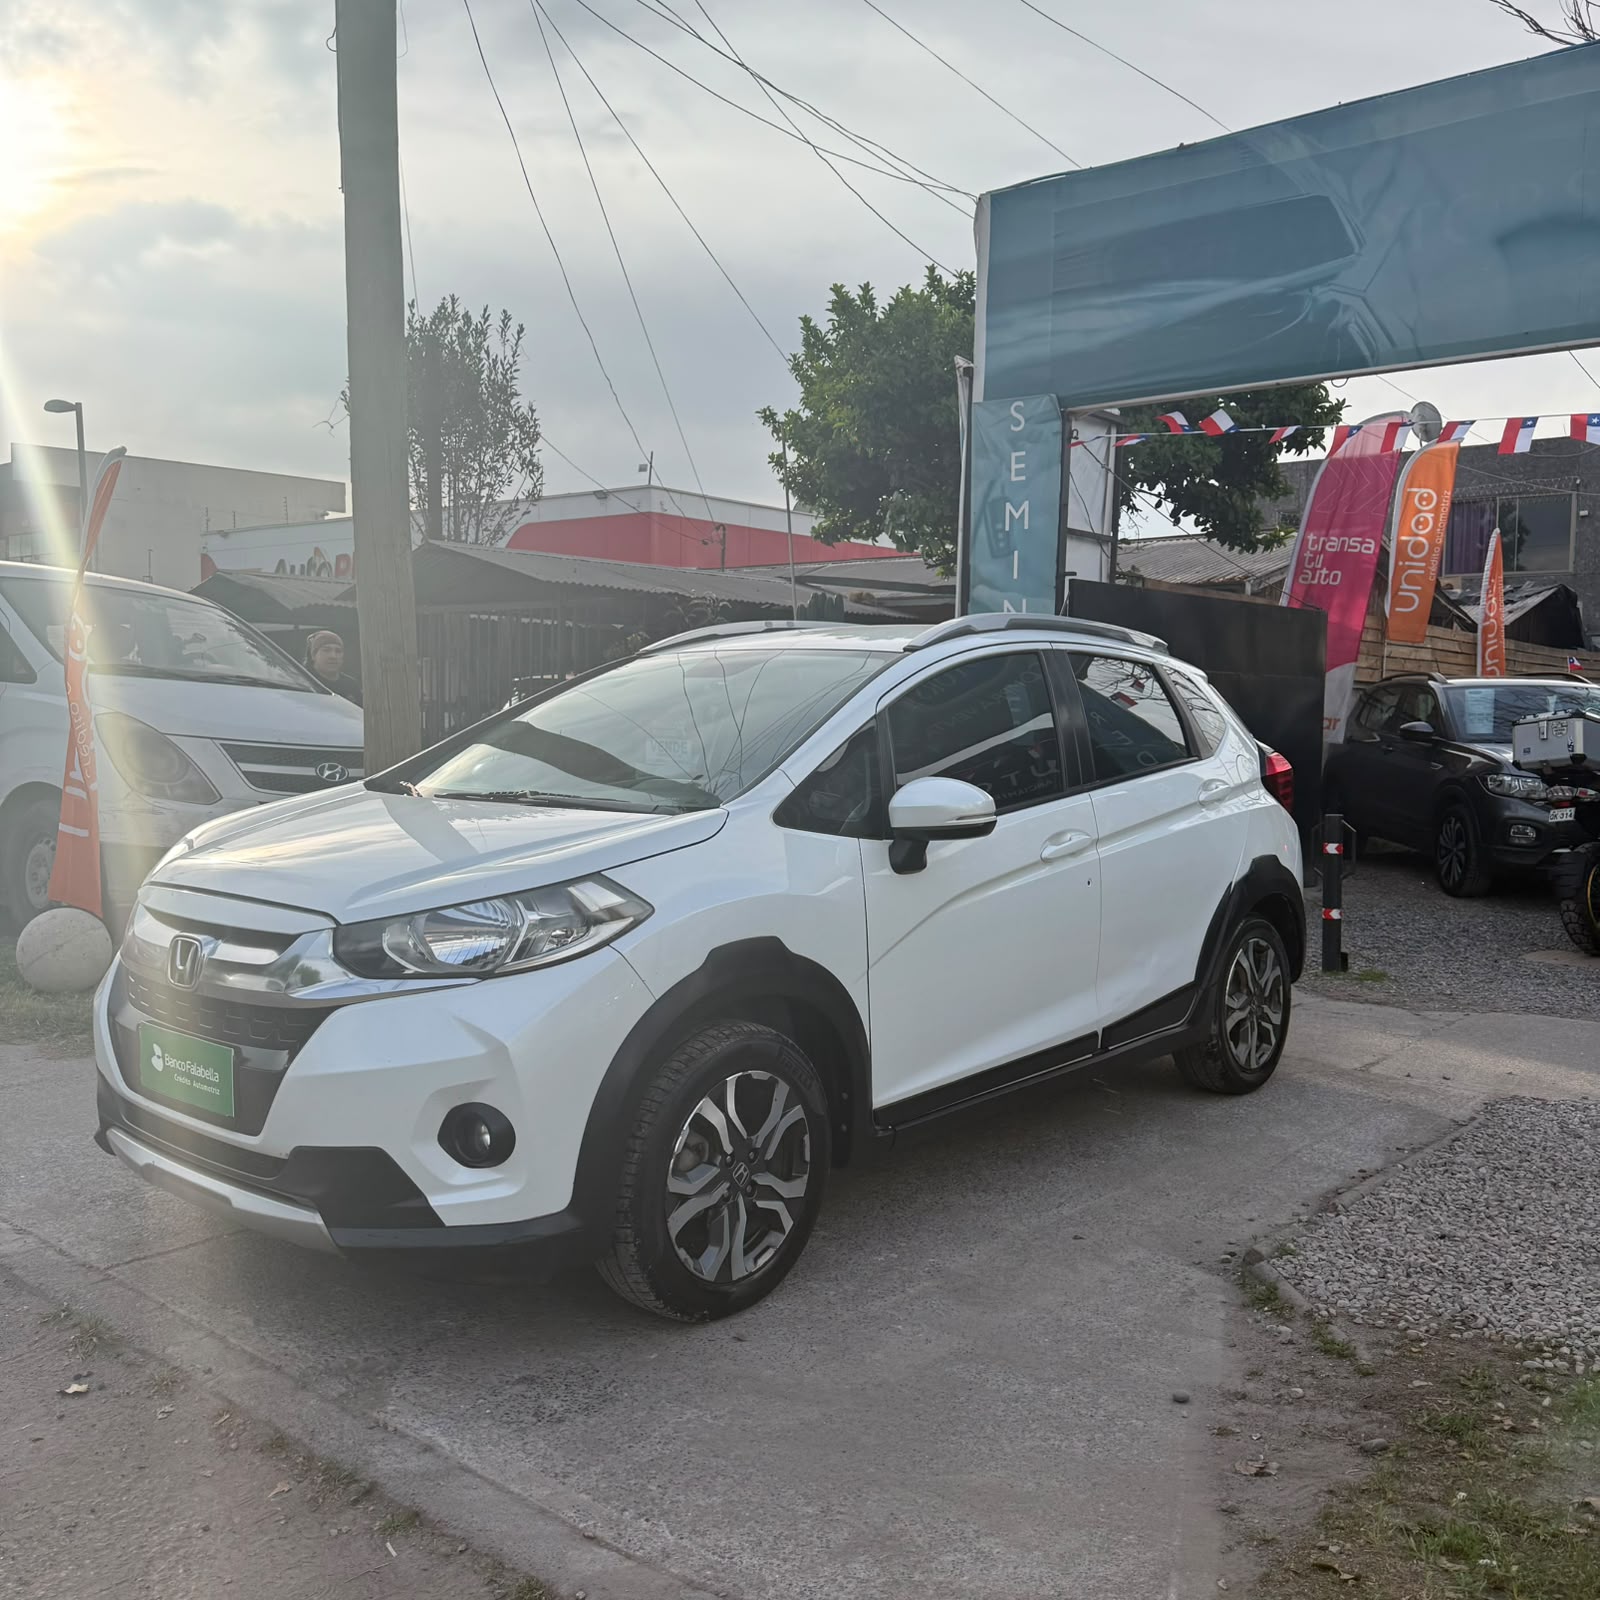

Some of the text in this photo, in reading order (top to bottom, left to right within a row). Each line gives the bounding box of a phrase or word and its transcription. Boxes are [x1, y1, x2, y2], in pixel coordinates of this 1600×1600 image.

[1436, 490, 1450, 543] automotriz
[1307, 532, 1376, 555] transa
[1395, 487, 1437, 612] unidad
[1304, 551, 1324, 568] tu
[1299, 567, 1342, 585] auto
[164, 1053, 220, 1083] Banco Falabella
